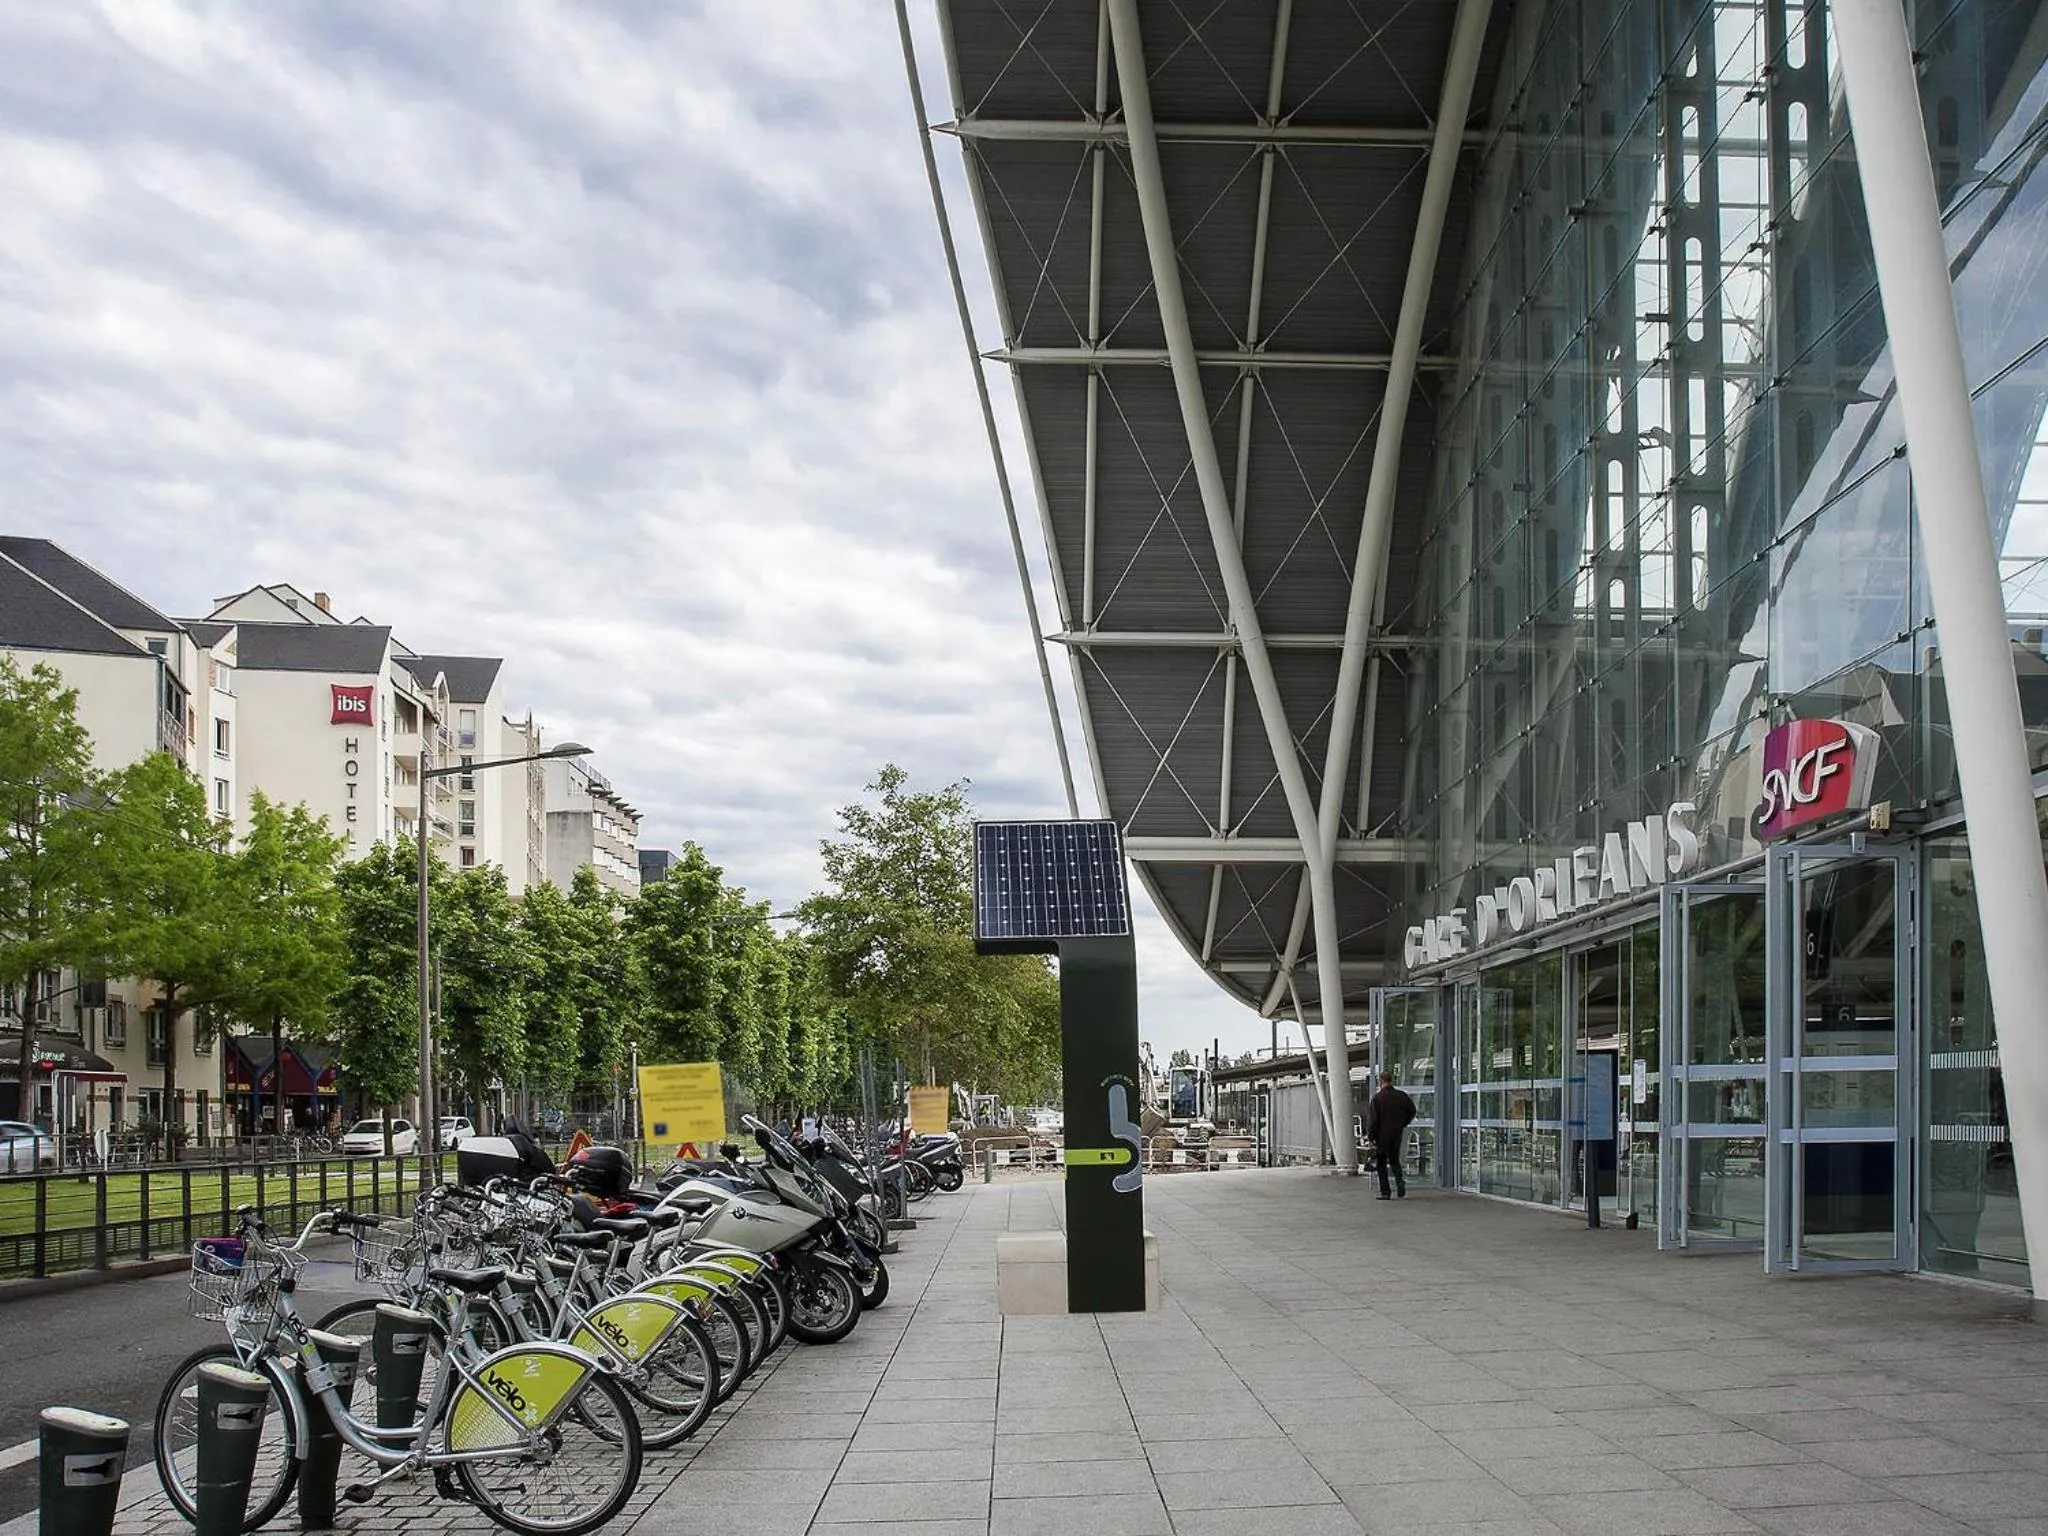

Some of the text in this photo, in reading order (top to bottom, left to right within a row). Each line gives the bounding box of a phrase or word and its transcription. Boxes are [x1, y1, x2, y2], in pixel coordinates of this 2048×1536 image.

[337, 694, 367, 713] ibis
[344, 736, 359, 845] HOTEL
[1758, 738, 1847, 824] SNCF
[1806, 932, 1815, 956] 6
[487, 1369, 527, 1412] vélo
